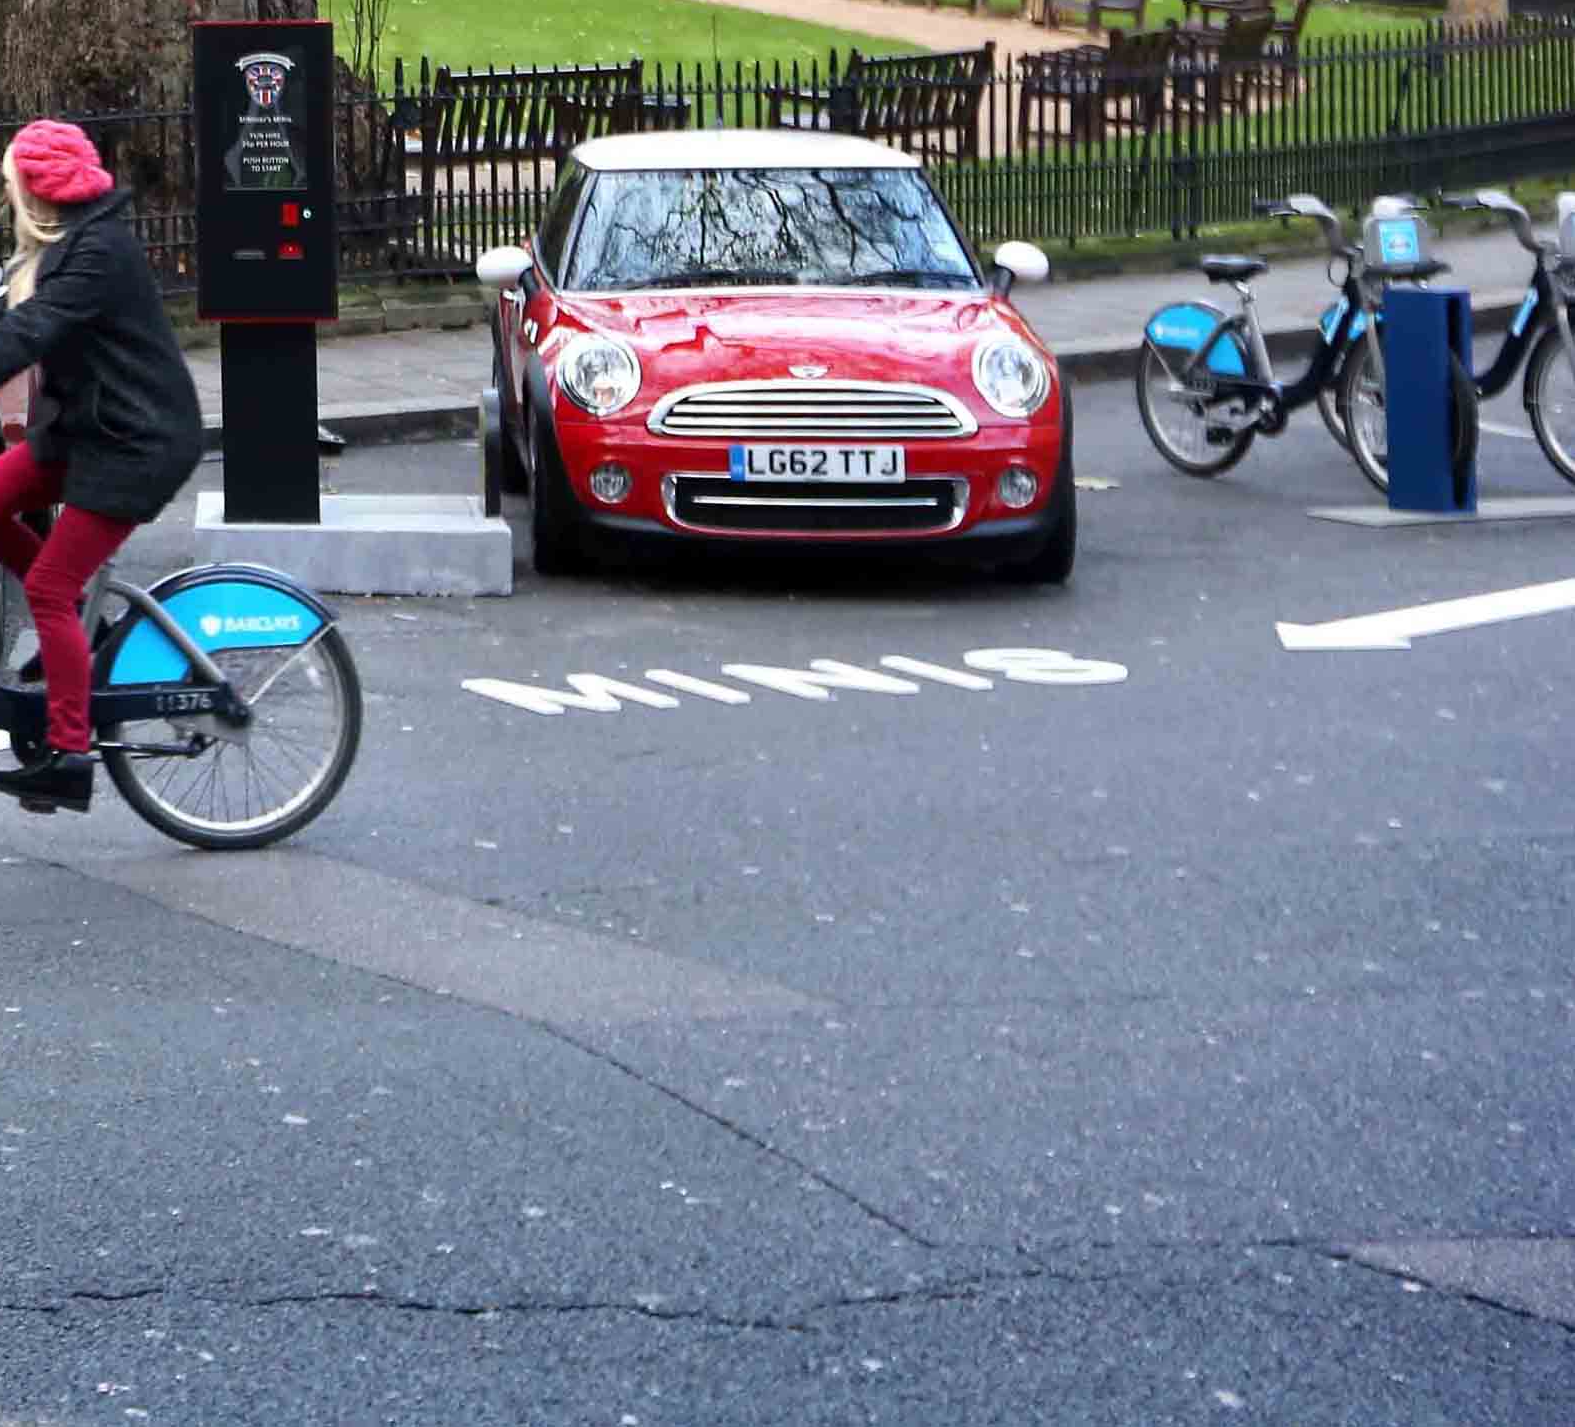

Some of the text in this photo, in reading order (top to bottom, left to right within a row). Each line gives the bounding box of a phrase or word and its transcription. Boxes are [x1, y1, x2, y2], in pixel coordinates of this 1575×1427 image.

[747, 449, 898, 476] LG62 TTJ
[461, 647, 1129, 715] MINIS
